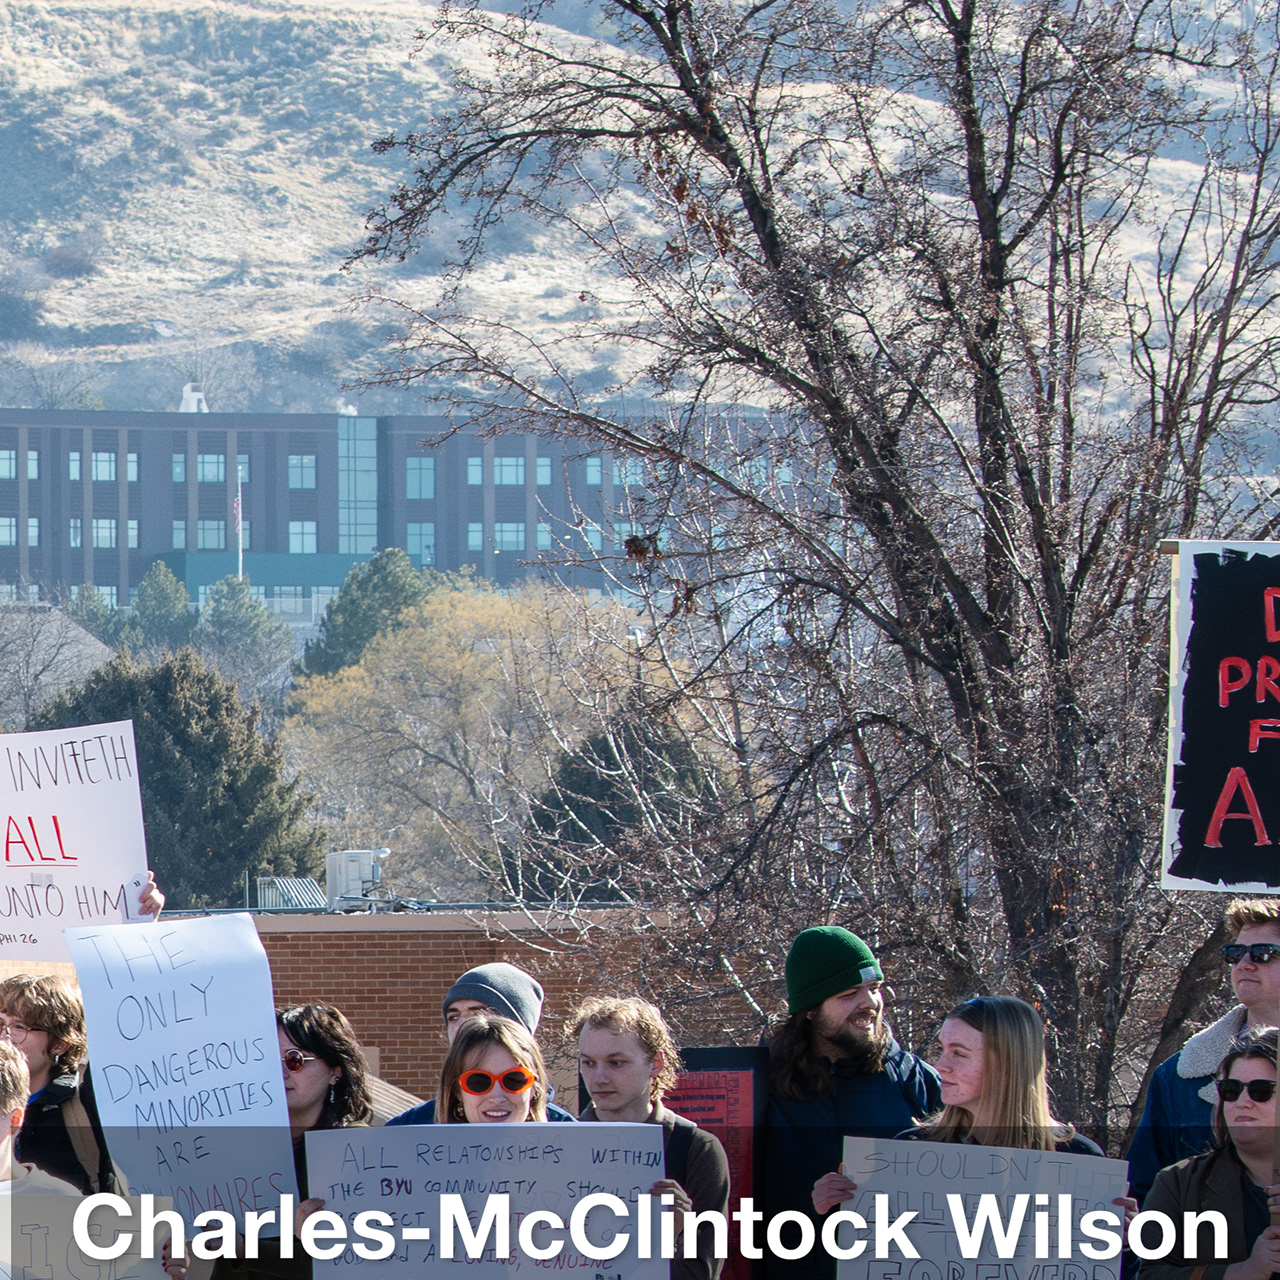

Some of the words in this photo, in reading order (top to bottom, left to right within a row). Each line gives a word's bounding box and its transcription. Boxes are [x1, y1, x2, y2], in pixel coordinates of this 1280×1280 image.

[5, 815, 79, 862] ALL
[20, 933, 38, 944] 26
[77, 930, 196, 990] THE
[116, 975, 215, 1041] ONLY
[102, 1037, 265, 1104] DANGEROUS
[135, 1080, 274, 1140] MINORITIES
[156, 1136, 210, 1177] ARE
[341, 1142, 399, 1173] ALL
[591, 1146, 662, 1168] WITHIN
[329, 1181, 365, 1201] THE
[380, 1178, 413, 1197] BYU
